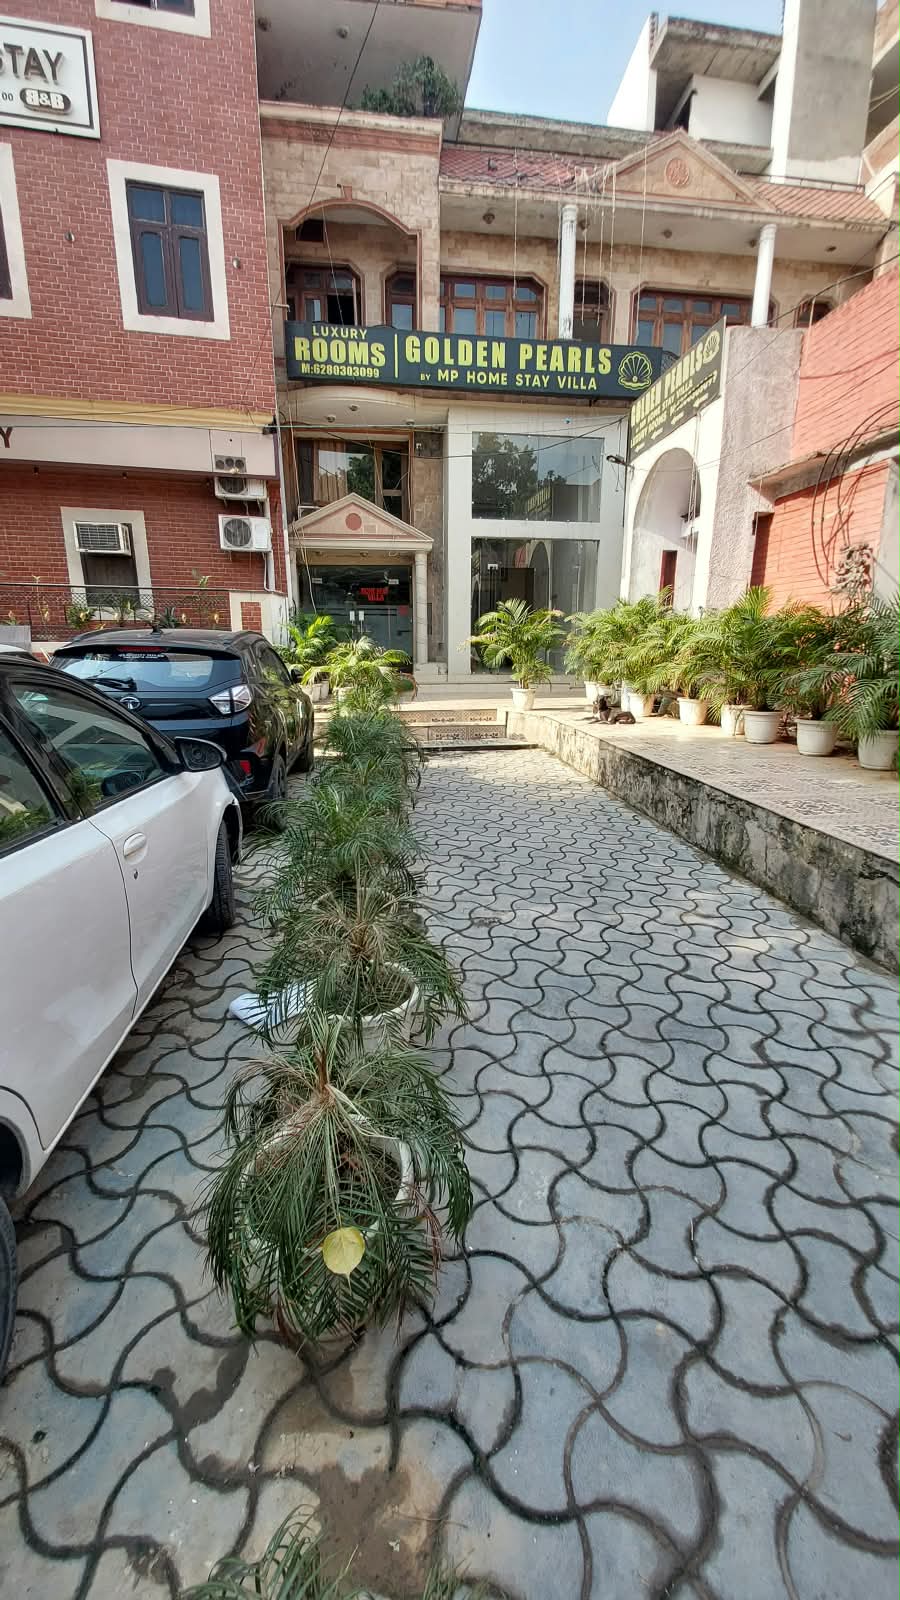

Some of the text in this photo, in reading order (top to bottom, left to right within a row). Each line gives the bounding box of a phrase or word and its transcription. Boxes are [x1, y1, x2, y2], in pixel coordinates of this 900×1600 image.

[312, 325, 367, 340] LUXURY
[294, 336, 386, 367] ROOMS
[405, 335, 612, 375] GOLDEN PEARLS
[301, 362, 380, 379] M:6280303099
[420, 368, 597, 390] BY MP HOME STAY VILLA
[663, 340, 703, 400] PEARLS
